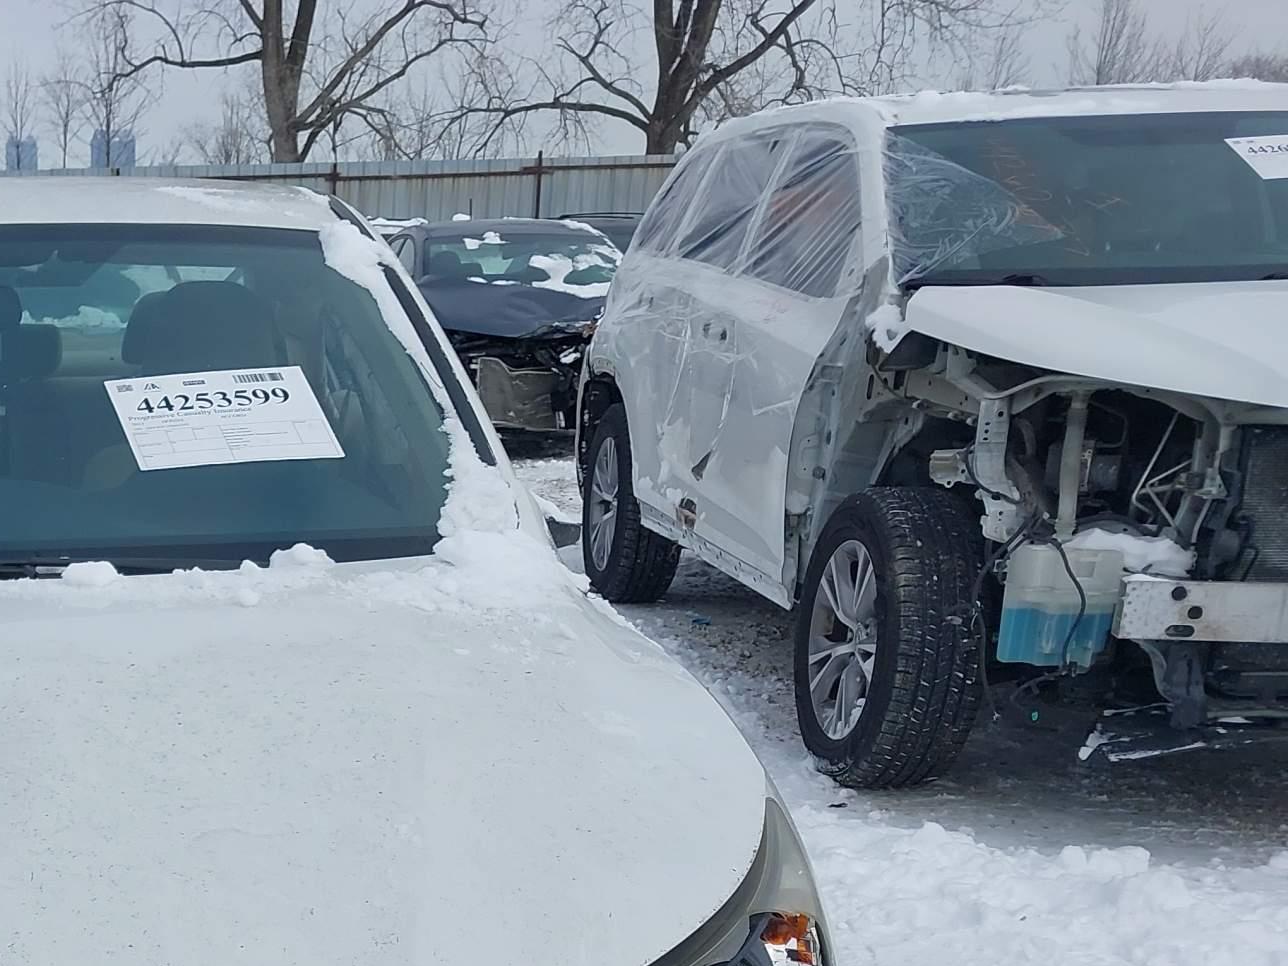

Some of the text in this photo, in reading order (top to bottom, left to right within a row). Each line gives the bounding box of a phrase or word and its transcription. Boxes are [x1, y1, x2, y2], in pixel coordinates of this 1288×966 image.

[136, 387, 290, 413] 44253599
[128, 412, 176, 422] Progressive
[177, 409, 211, 418] Casualty
[213, 406, 251, 414] Insurance
